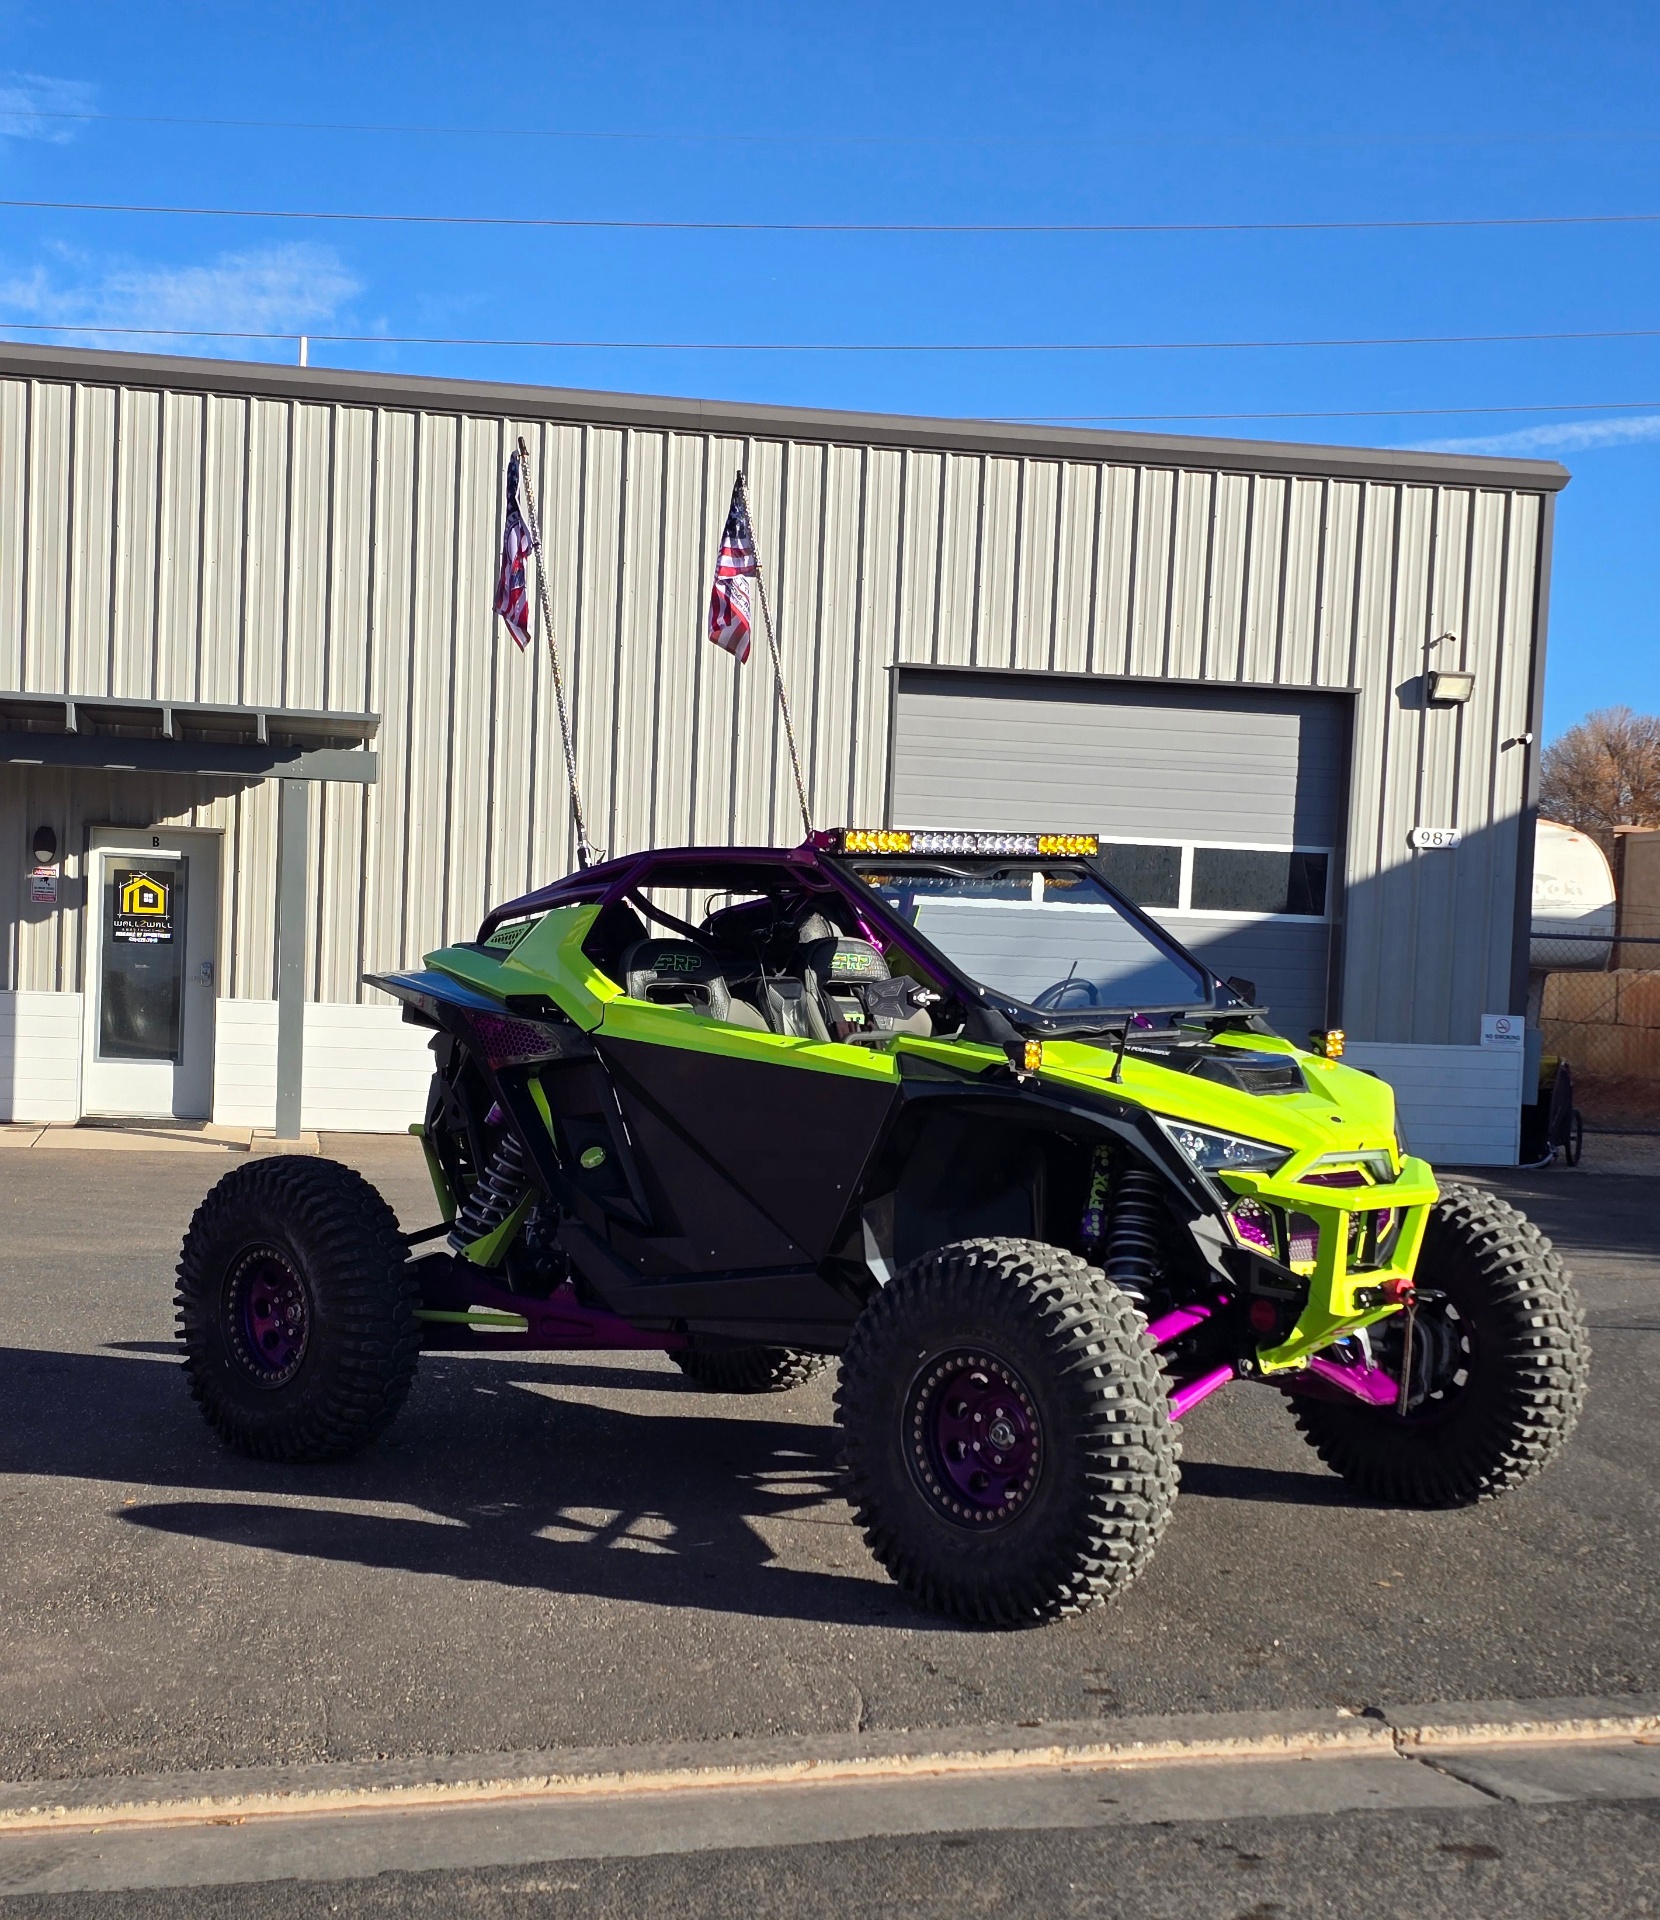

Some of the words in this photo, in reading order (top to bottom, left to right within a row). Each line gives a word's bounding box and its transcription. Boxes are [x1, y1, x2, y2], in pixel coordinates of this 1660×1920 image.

[152, 836, 160, 848] B
[1421, 831, 1455, 846] 987
[651, 953, 701, 971] PRP
[828, 952, 872, 970] PRP
